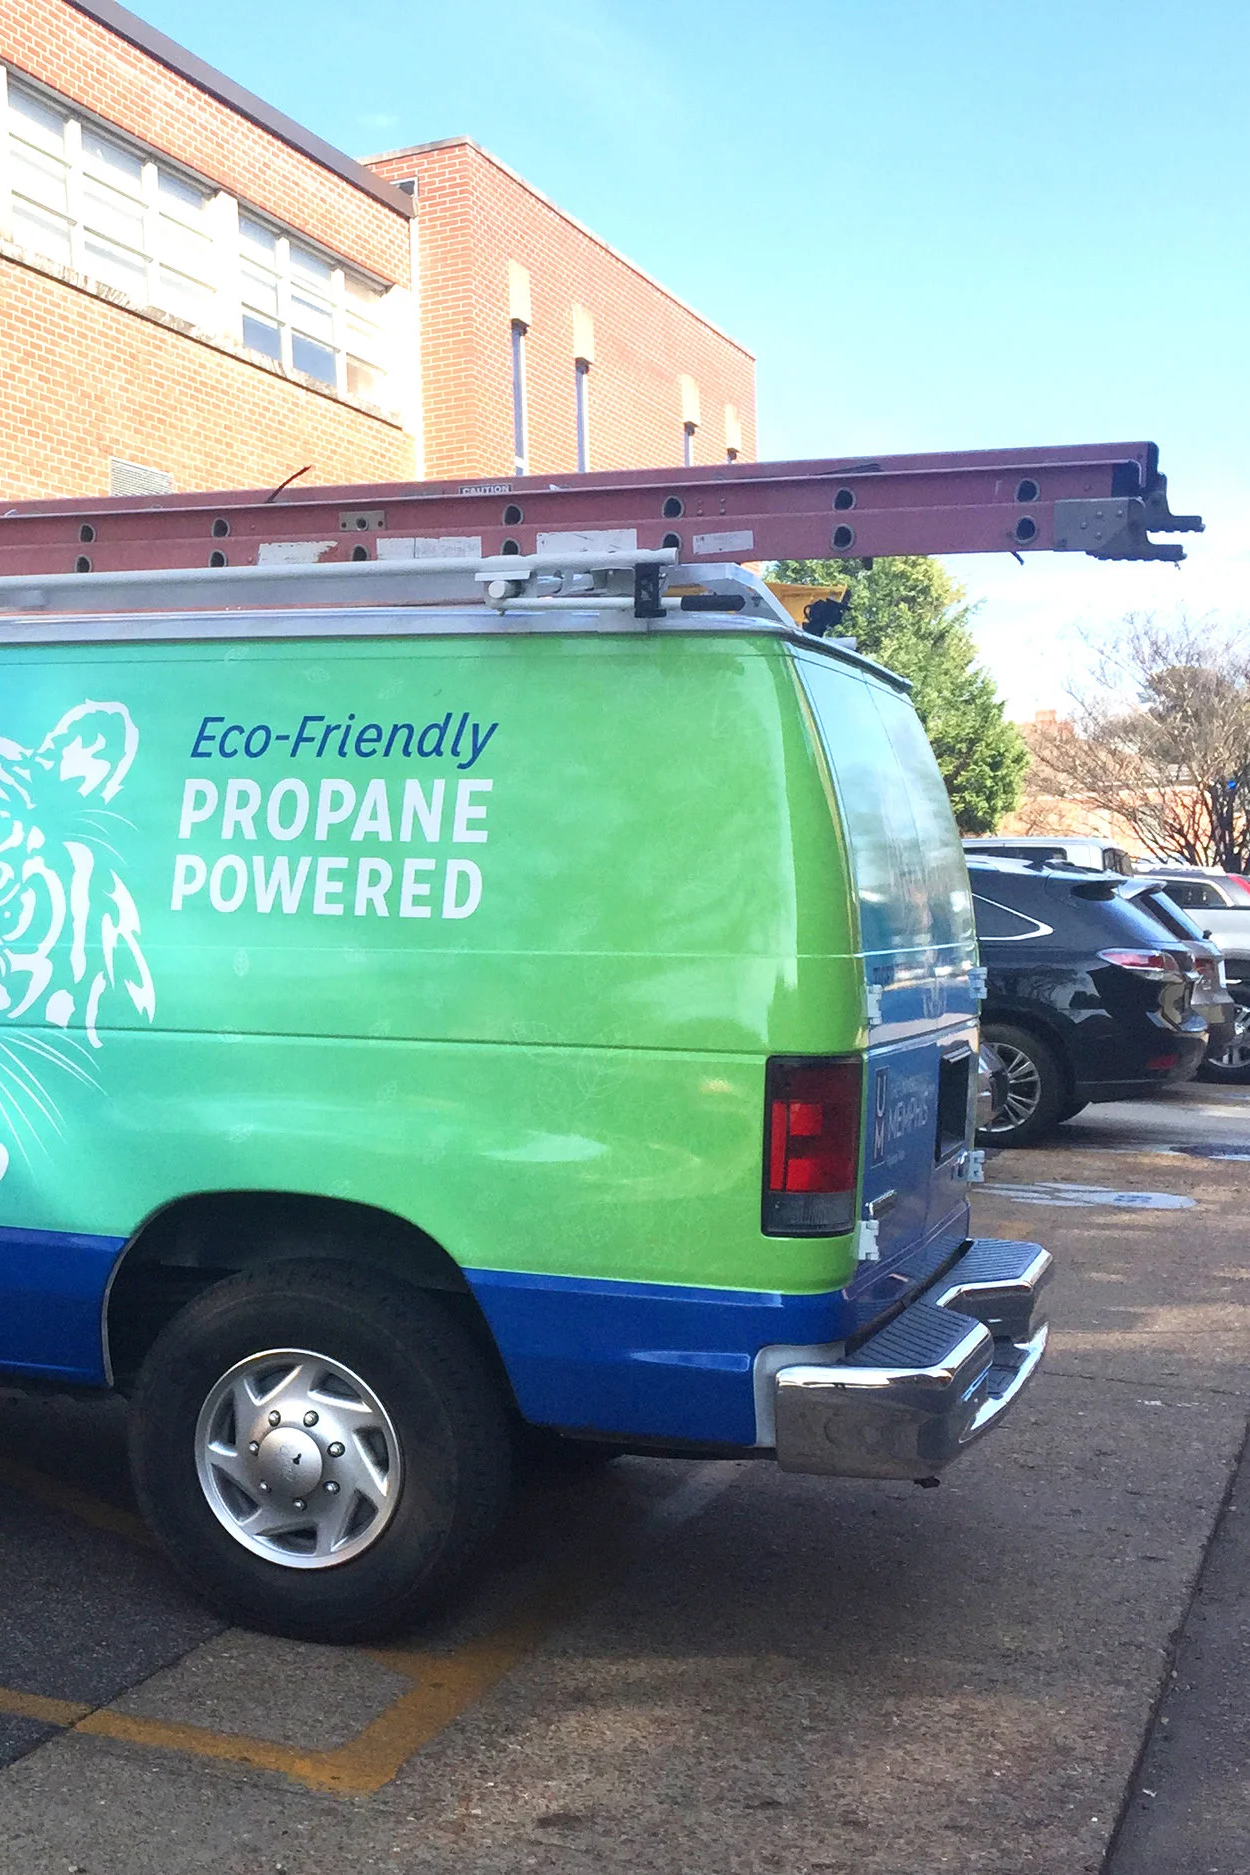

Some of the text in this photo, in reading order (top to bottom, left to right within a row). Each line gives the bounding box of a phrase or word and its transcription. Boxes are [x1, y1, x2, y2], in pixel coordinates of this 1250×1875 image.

[461, 485, 510, 497] CAUTION
[190, 712, 499, 770] Eco-Friendly
[178, 778, 494, 843] PROPANE
[170, 854, 483, 919] POWERED
